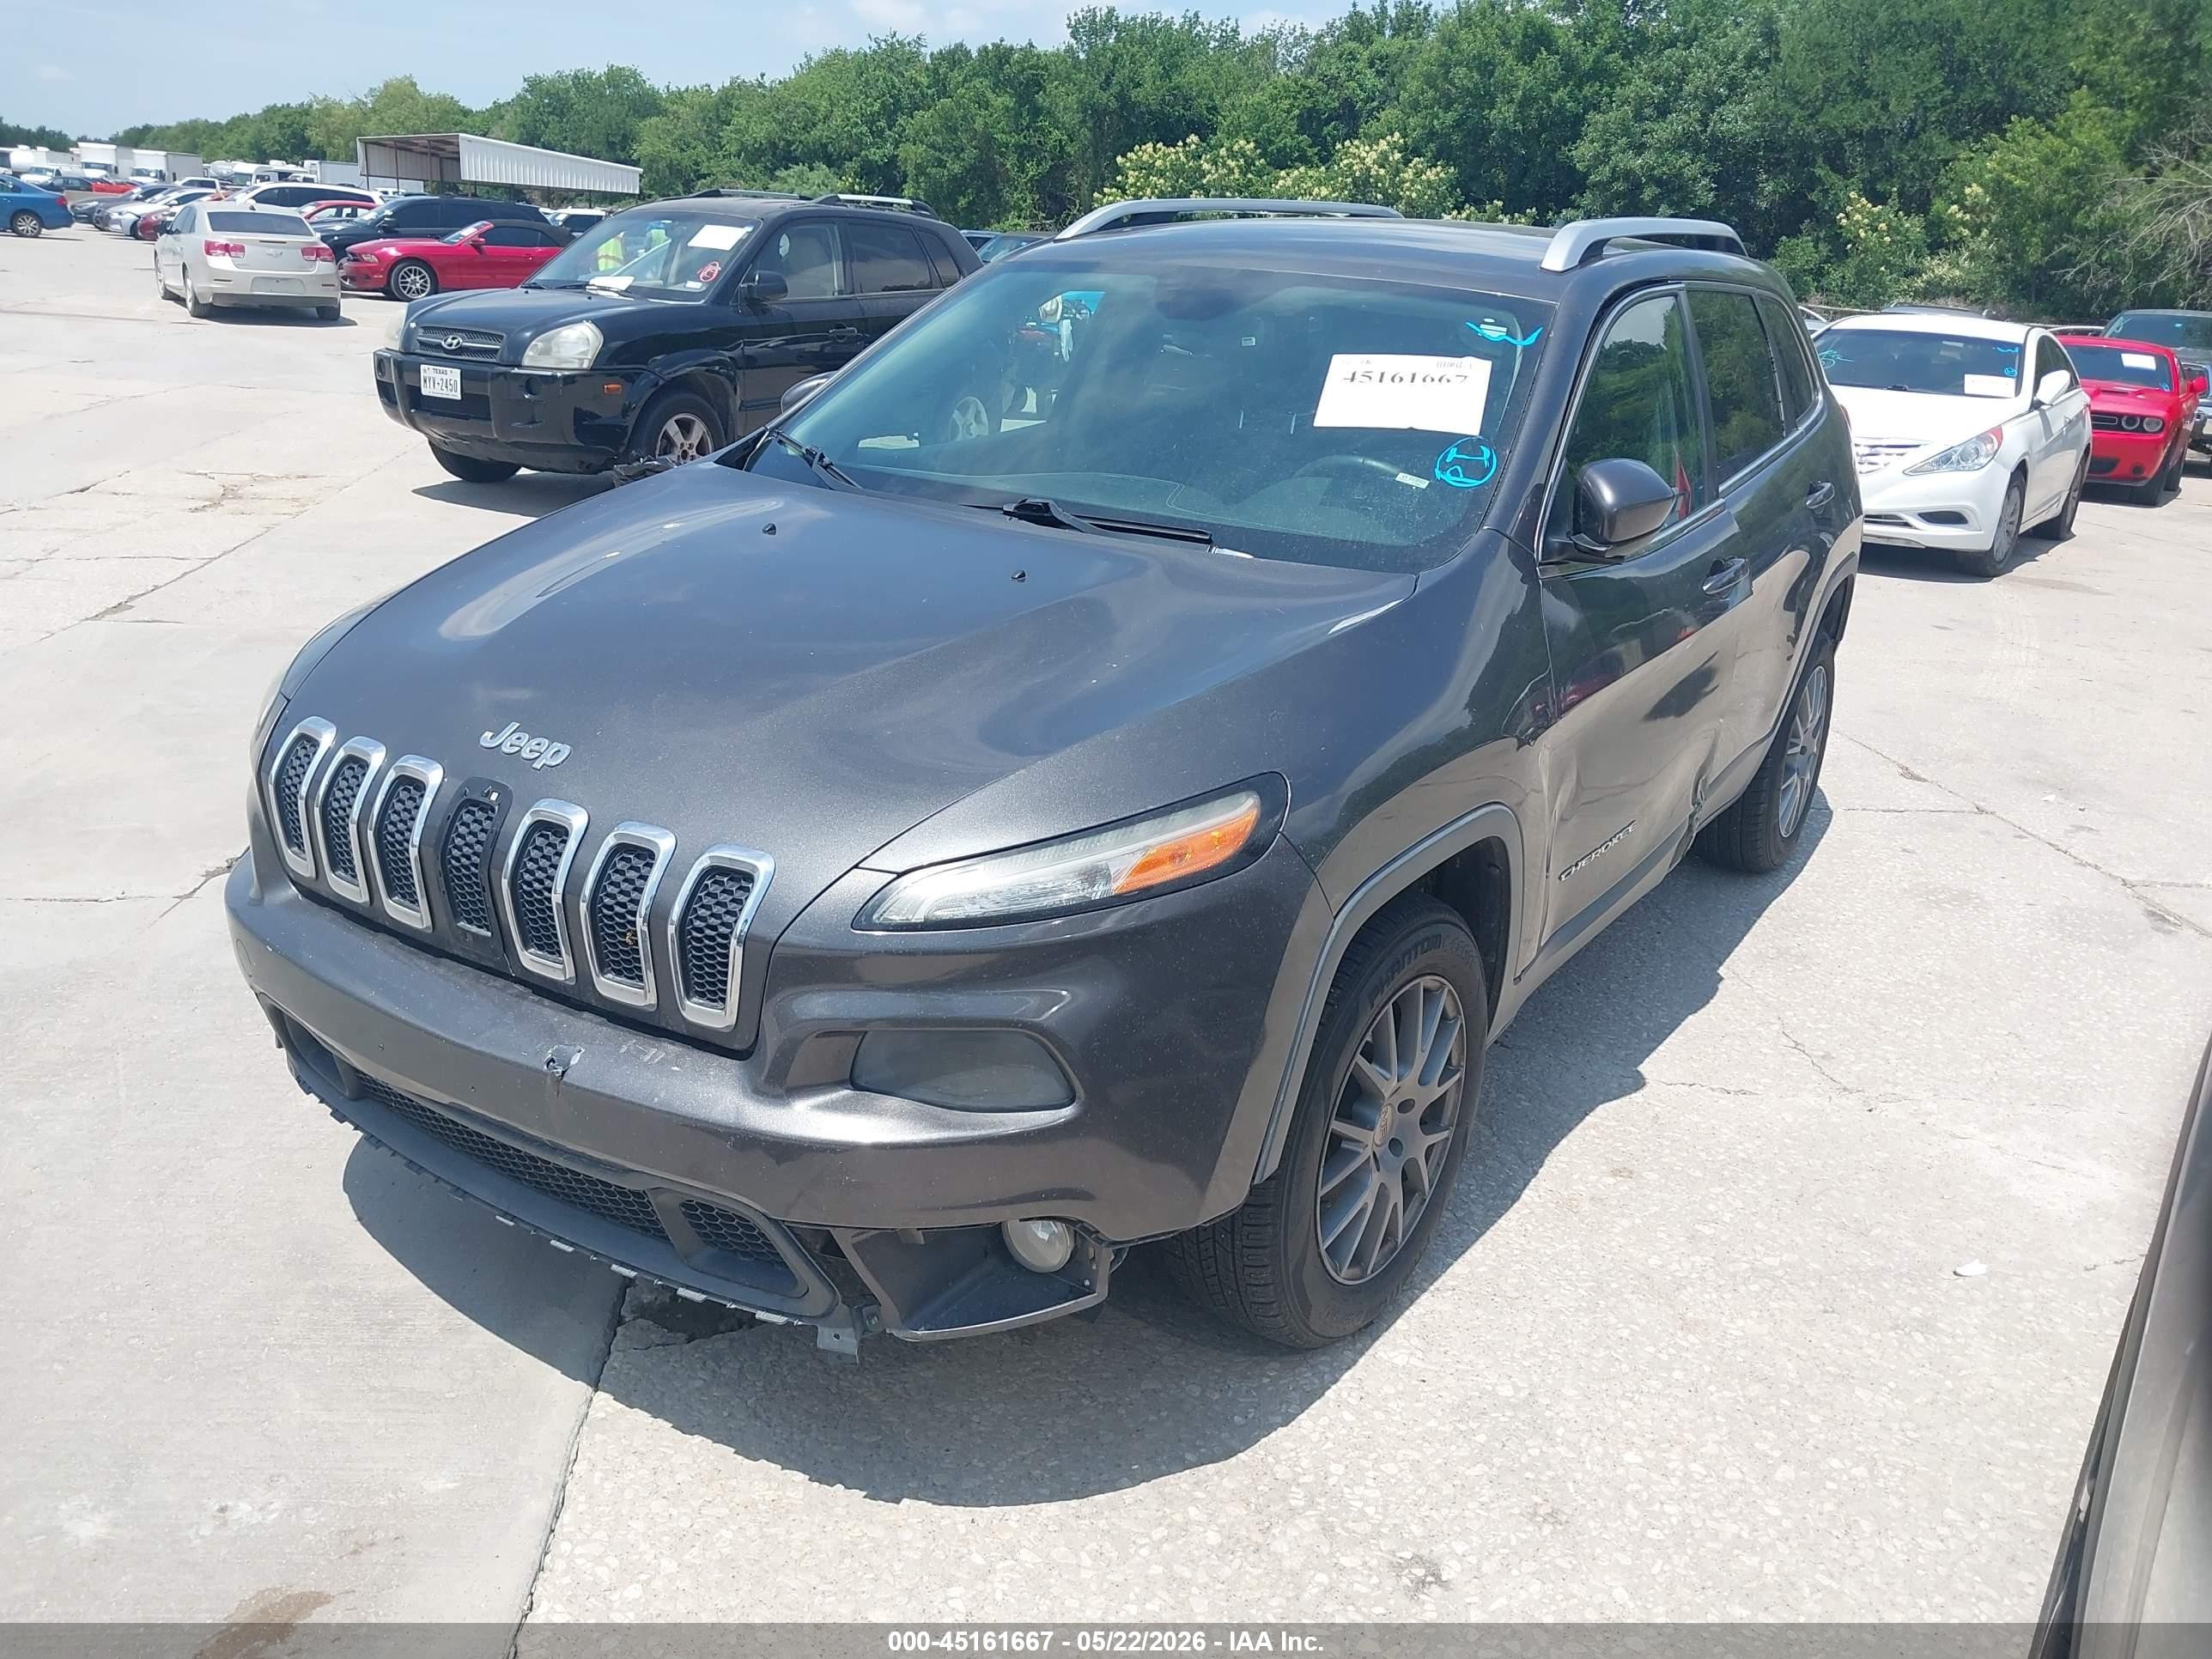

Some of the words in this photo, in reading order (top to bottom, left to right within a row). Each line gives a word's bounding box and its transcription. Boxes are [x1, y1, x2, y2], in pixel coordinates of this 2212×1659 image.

[1341, 370, 1468, 384] 45161667
[479, 721, 573, 771] Jeep
[1558, 820, 1637, 882] CHEROKEE
